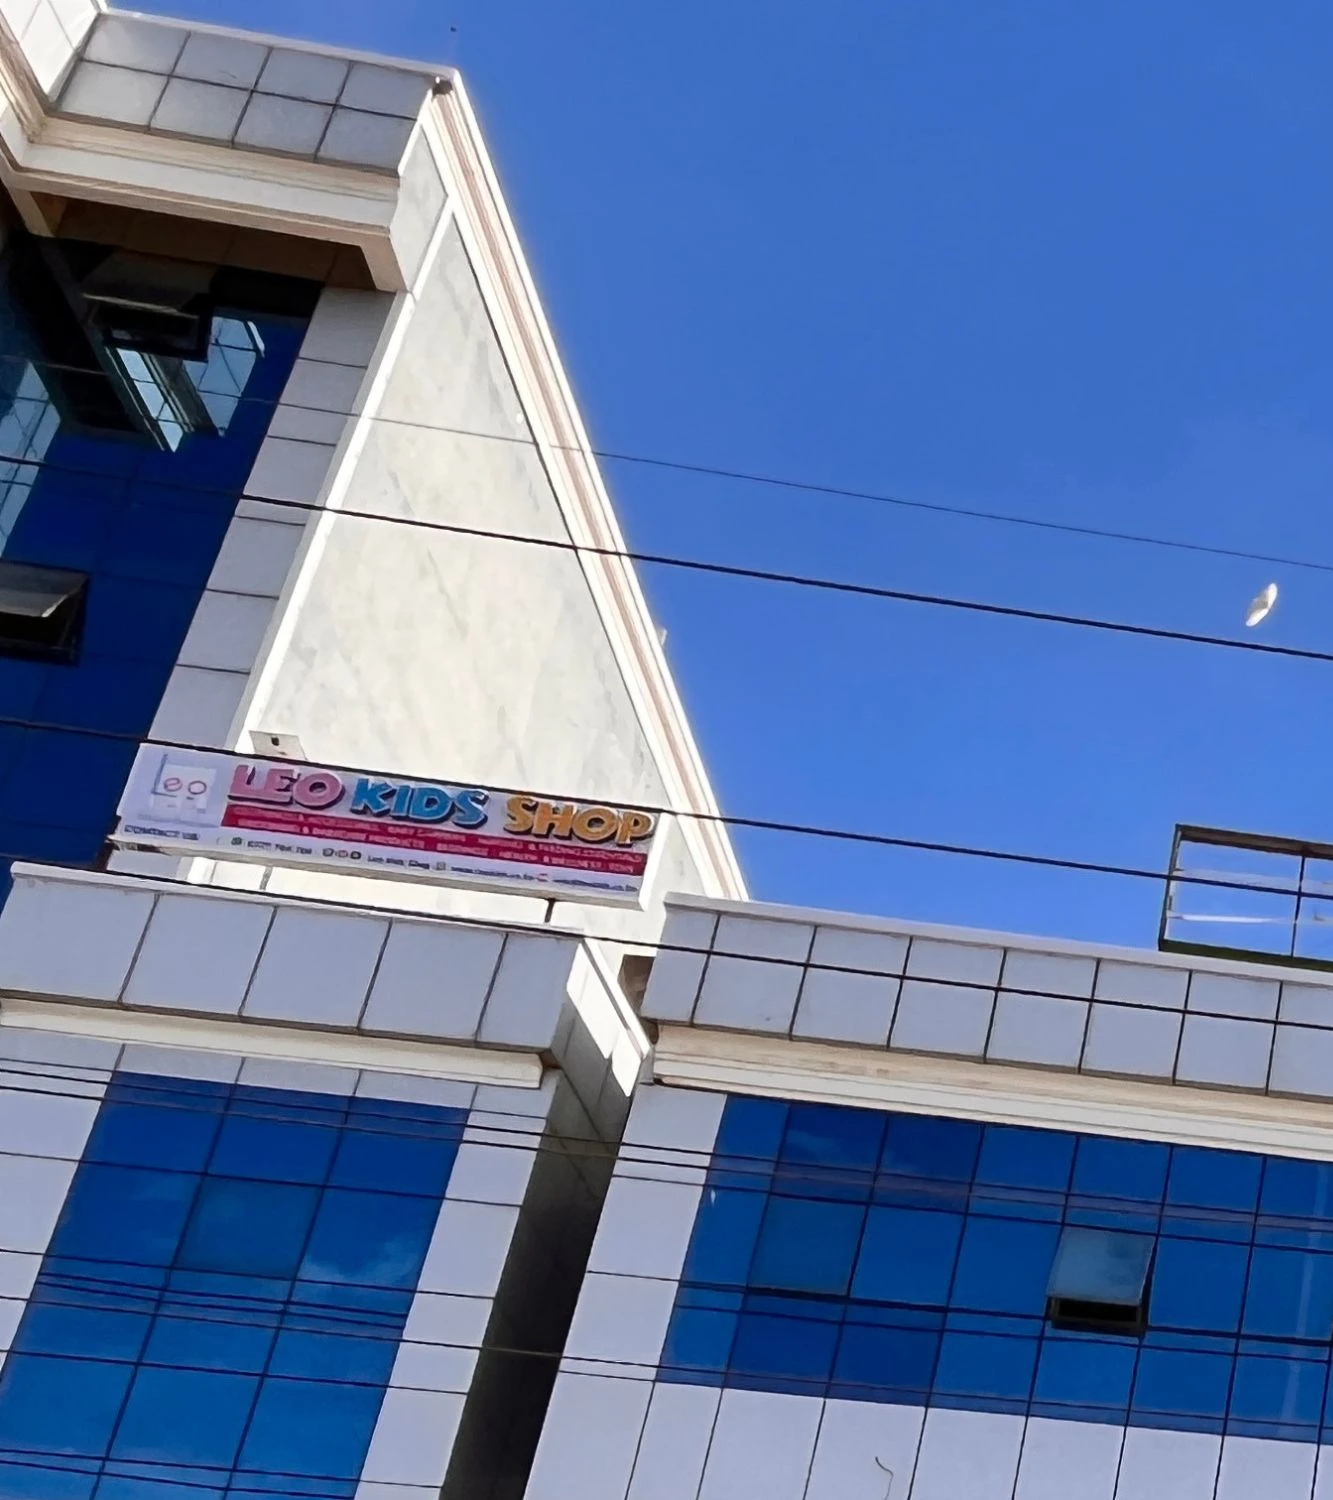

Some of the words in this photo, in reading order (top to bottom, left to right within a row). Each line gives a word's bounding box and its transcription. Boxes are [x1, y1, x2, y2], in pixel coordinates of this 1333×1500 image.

[228, 764, 345, 808] LEO
[350, 778, 490, 830] KIDS
[502, 795, 655, 846] SHOP
